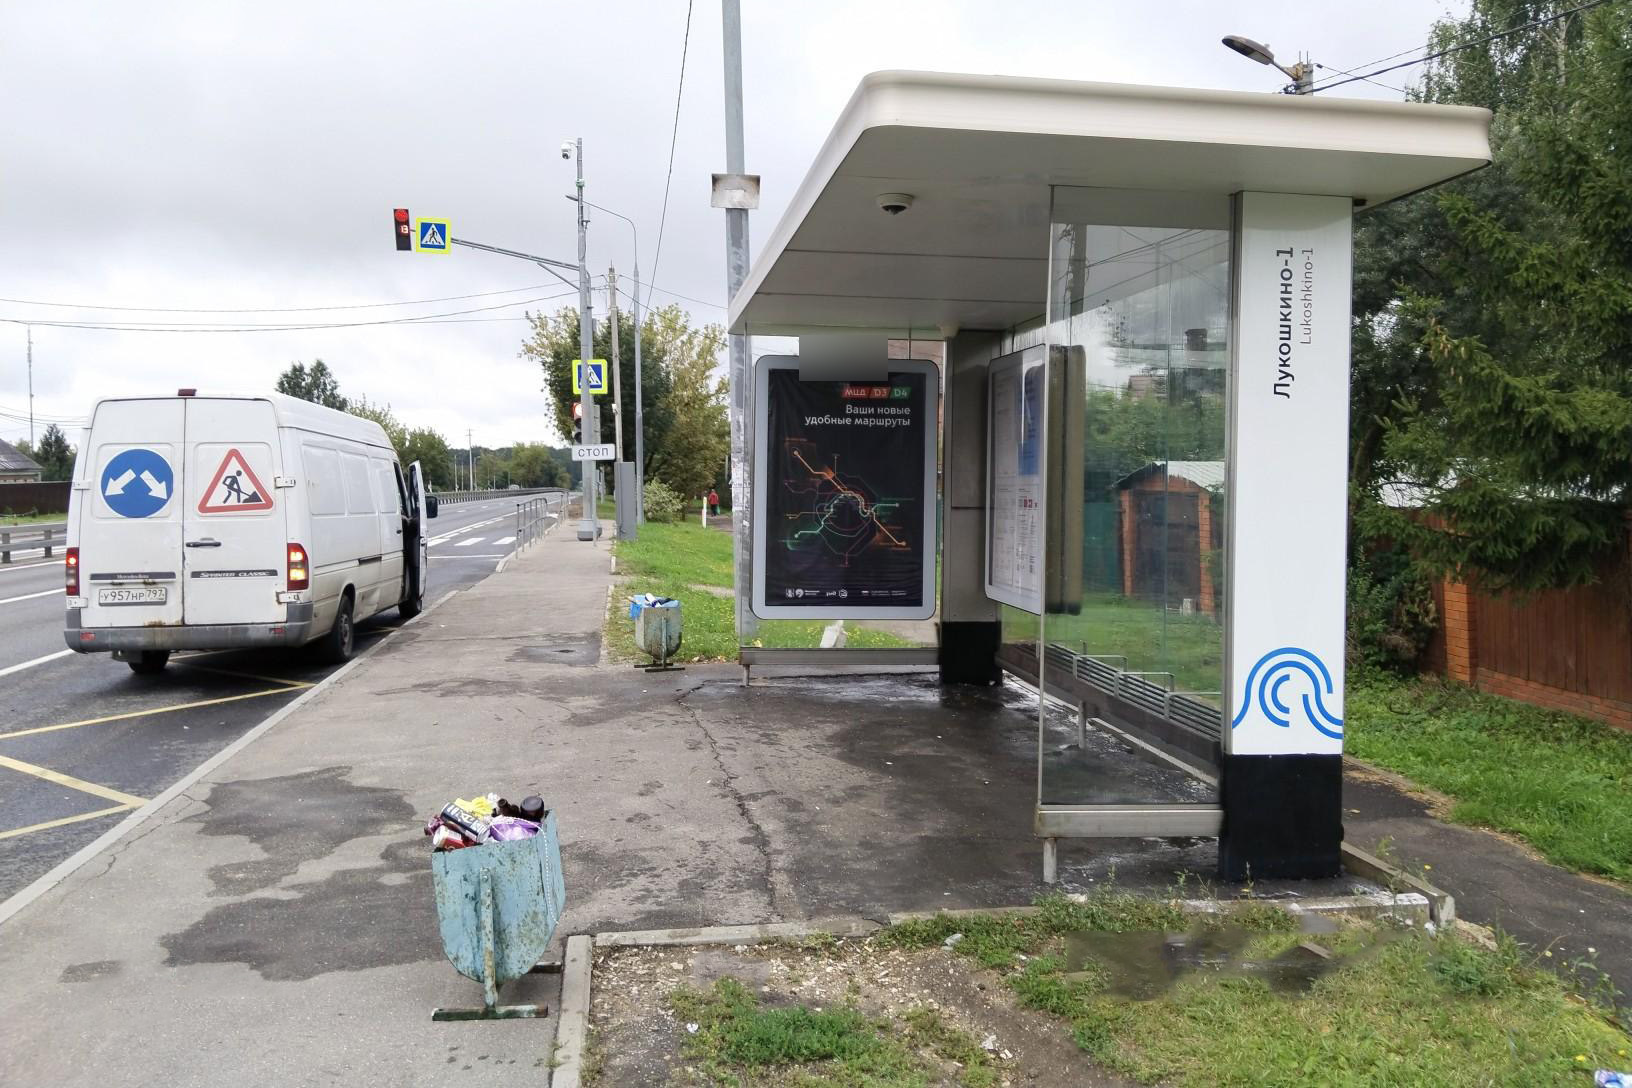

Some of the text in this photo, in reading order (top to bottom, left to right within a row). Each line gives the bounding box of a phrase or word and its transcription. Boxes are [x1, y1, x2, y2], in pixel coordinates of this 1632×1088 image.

[1300, 248, 1313, 345] Lukoshkino-1
[1274, 247, 1294, 399] Лукошкино-1
[894, 388, 908, 396] D4
[845, 404, 911, 415] Ваши новые
[804, 415, 911, 428] удобные маршруты
[578, 448, 609, 457] СТОП
